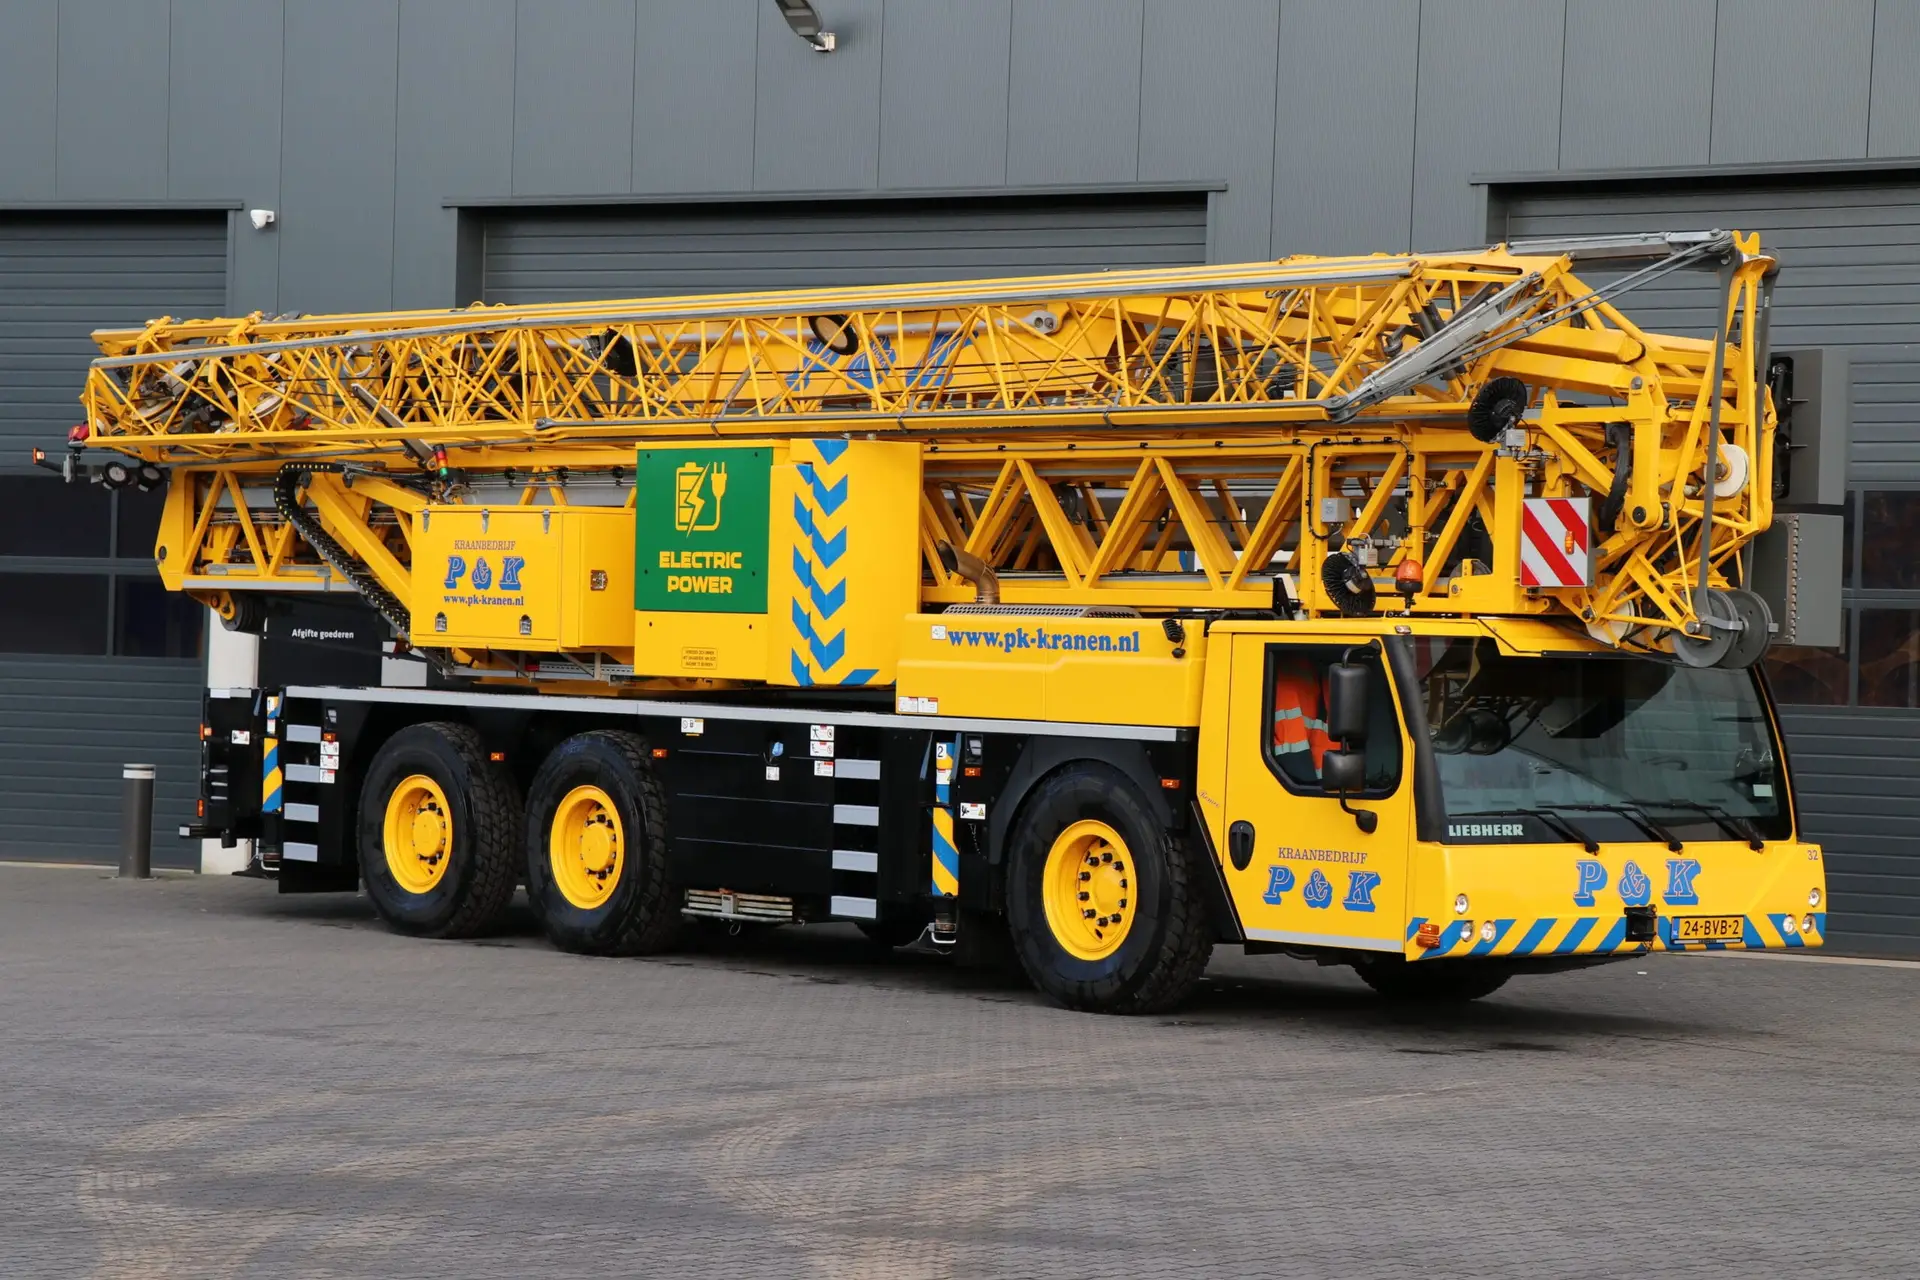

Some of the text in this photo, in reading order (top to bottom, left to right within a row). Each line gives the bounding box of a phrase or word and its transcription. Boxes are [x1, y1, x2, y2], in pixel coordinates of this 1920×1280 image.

[454, 540, 516, 551] KRAANBEDRIJF
[659, 551, 742, 569] ELECTRIC
[444, 555, 525, 591] P & K
[667, 575, 733, 593] POWER
[444, 594, 524, 607] www.pk-kranen.nl
[291, 628, 354, 640] Afgifte goederen
[948, 628, 1140, 652] www.pk-kranen.nl
[937, 745, 944, 758] 2
[1448, 824, 1524, 837] LIEBHERR
[1278, 847, 1368, 864] KRAANBEDRIJF
[1807, 849, 1819, 861] 32
[1262, 864, 1381, 913] P & K
[1573, 859, 1701, 907] P & K
[1683, 919, 1739, 936] 24-BVB-2
